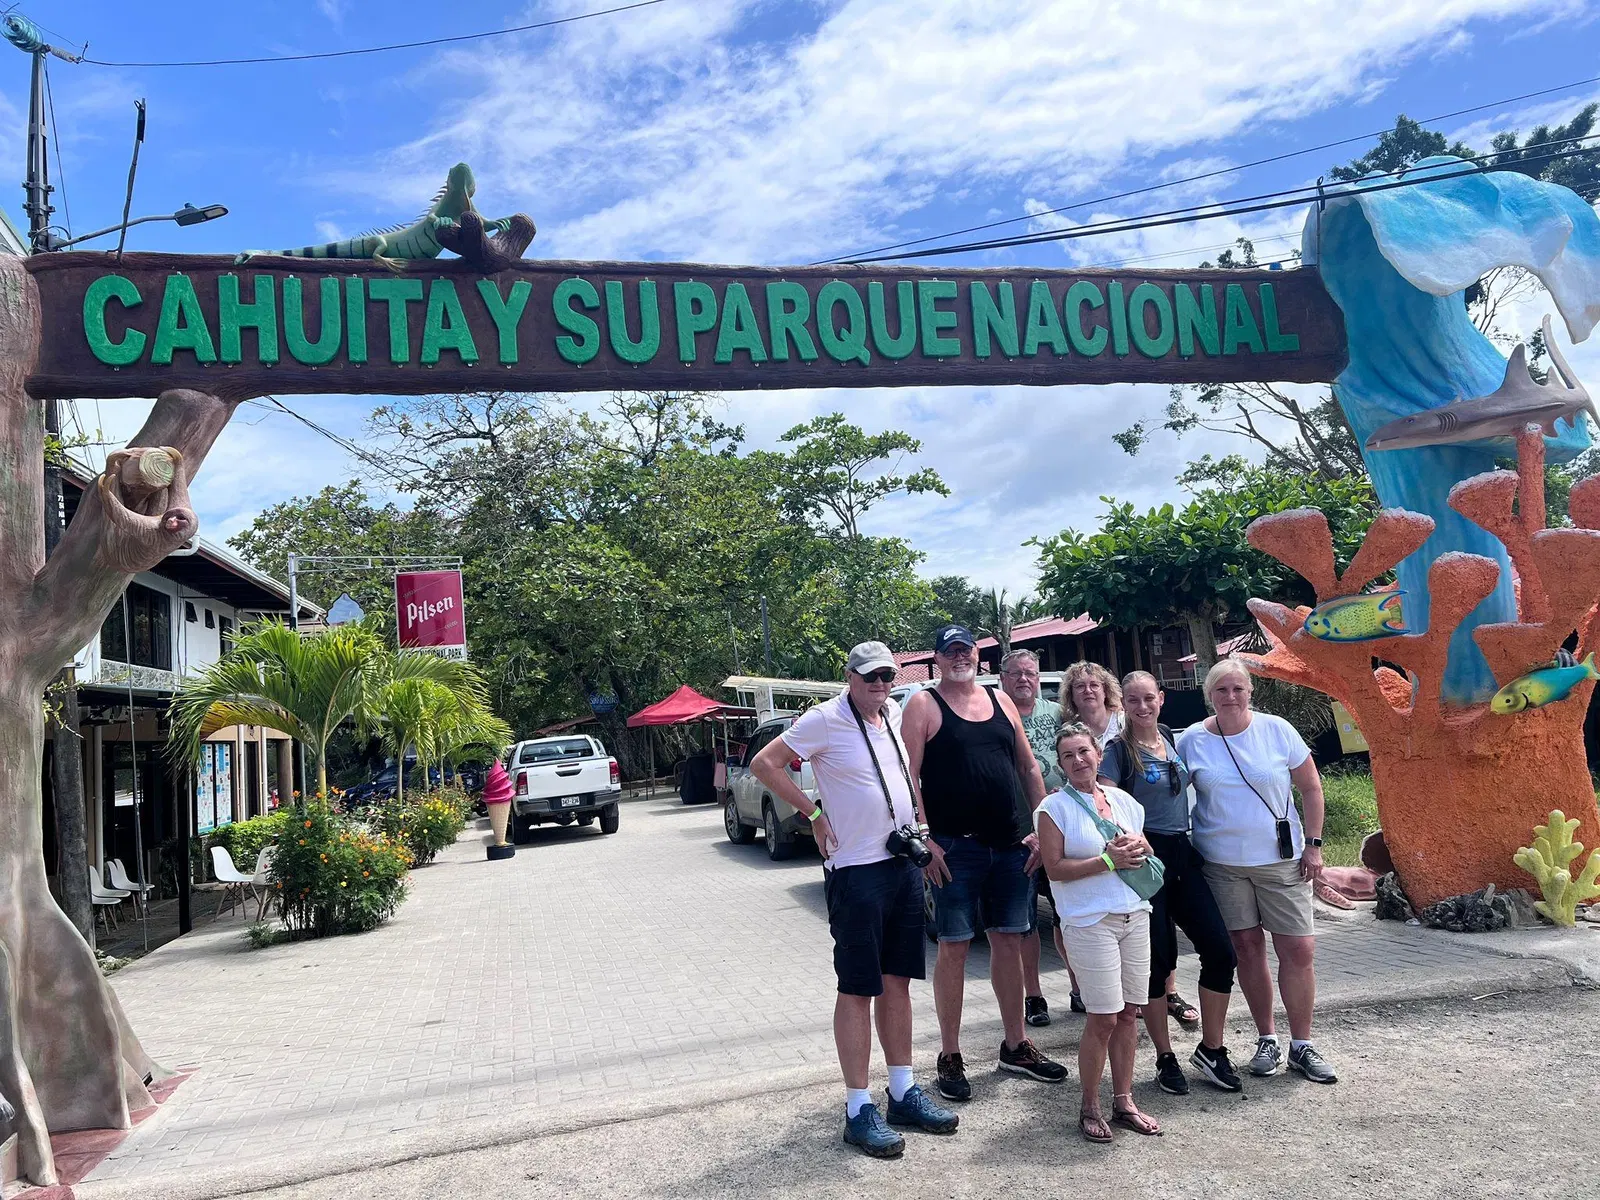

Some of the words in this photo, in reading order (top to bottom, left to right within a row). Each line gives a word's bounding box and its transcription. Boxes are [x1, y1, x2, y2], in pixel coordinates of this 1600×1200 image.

[553, 277, 661, 364] SU
[674, 279, 961, 367] PARQUE
[970, 280, 1300, 359] NACIONAL
[406, 596, 454, 629] Pilsen
